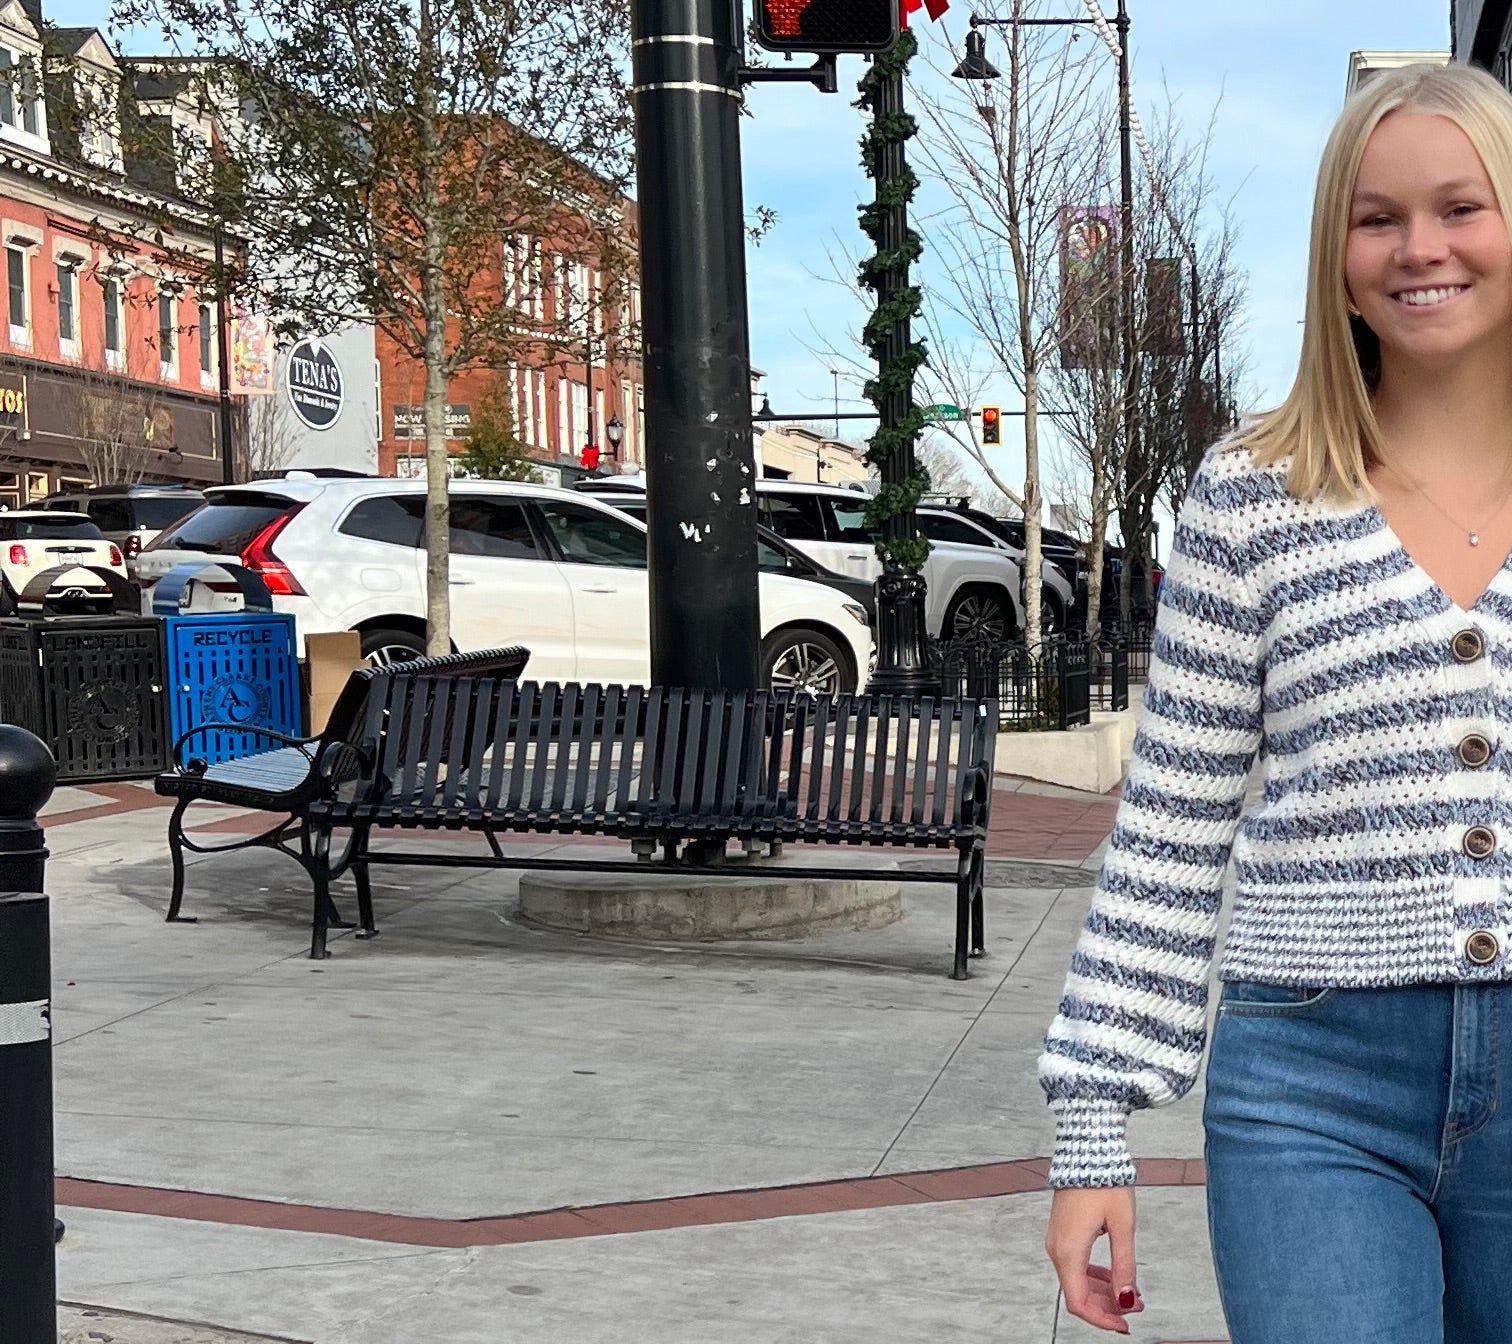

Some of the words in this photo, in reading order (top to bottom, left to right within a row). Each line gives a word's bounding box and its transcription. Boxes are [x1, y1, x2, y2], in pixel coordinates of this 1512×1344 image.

[292, 356, 338, 392] TENA'S
[53, 633, 148, 652] LANDFILL
[194, 629, 273, 646] RECYCLE
